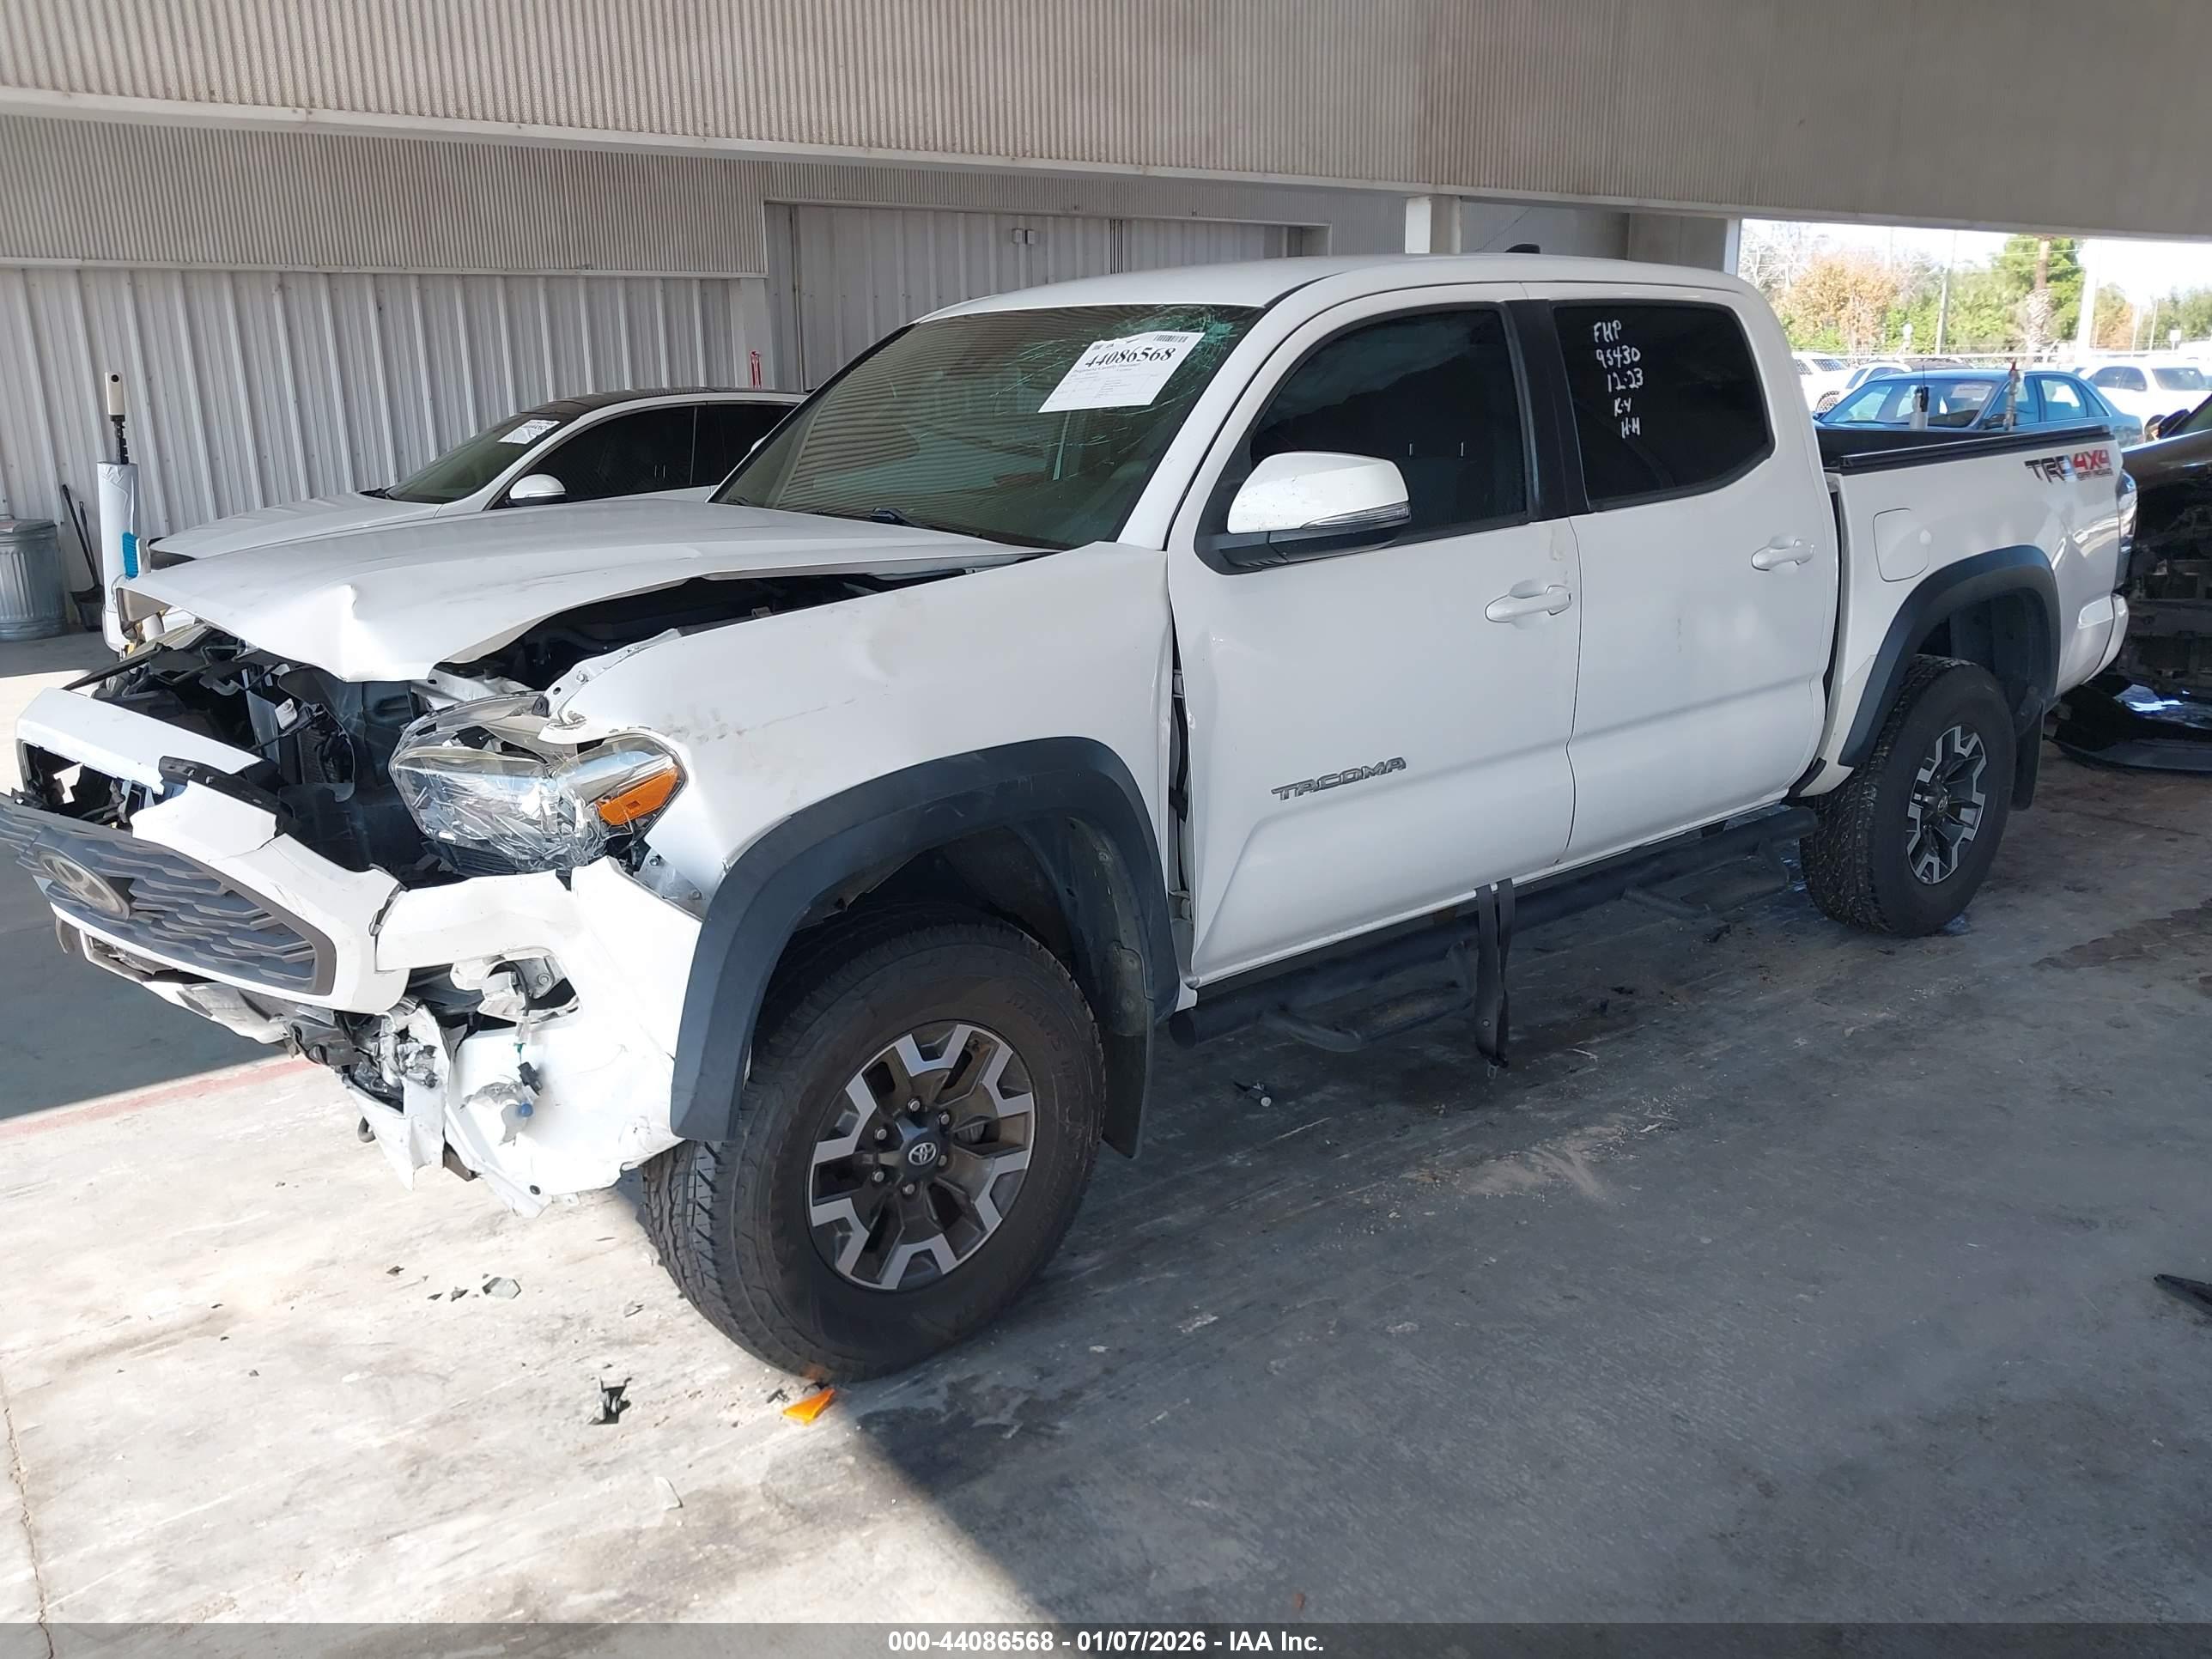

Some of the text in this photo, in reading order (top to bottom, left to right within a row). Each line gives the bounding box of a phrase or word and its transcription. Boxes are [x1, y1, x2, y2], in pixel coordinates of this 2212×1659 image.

[1594, 319, 1622, 343] FHP
[1085, 346, 1176, 368] 44086568
[1596, 345, 1641, 368] 95430
[1271, 757, 1407, 800] TACOMA
